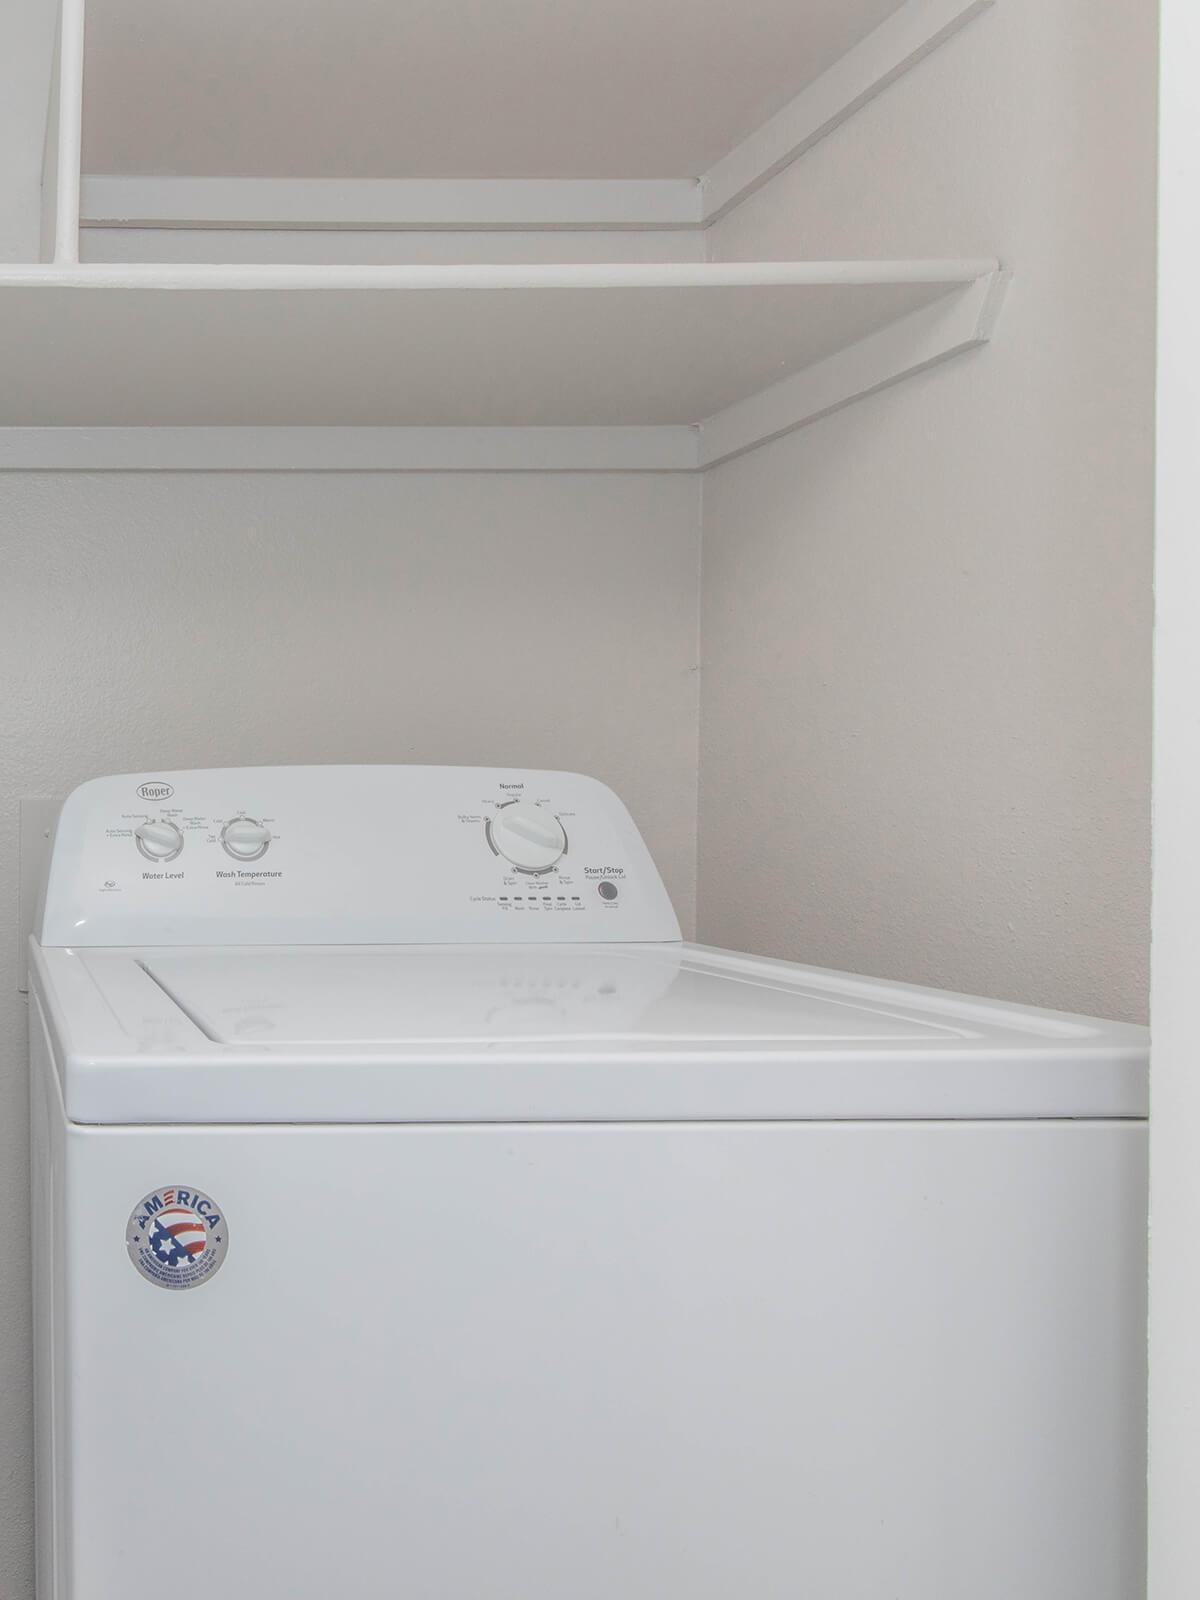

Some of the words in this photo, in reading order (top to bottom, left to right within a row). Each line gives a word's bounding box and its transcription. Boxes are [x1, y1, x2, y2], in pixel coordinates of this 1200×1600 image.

[141, 787, 170, 798] Roper
[237, 871, 282, 879] Temperature
[584, 866, 623, 875] Start/Stop
[136, 1189, 221, 1230] AMERICA
